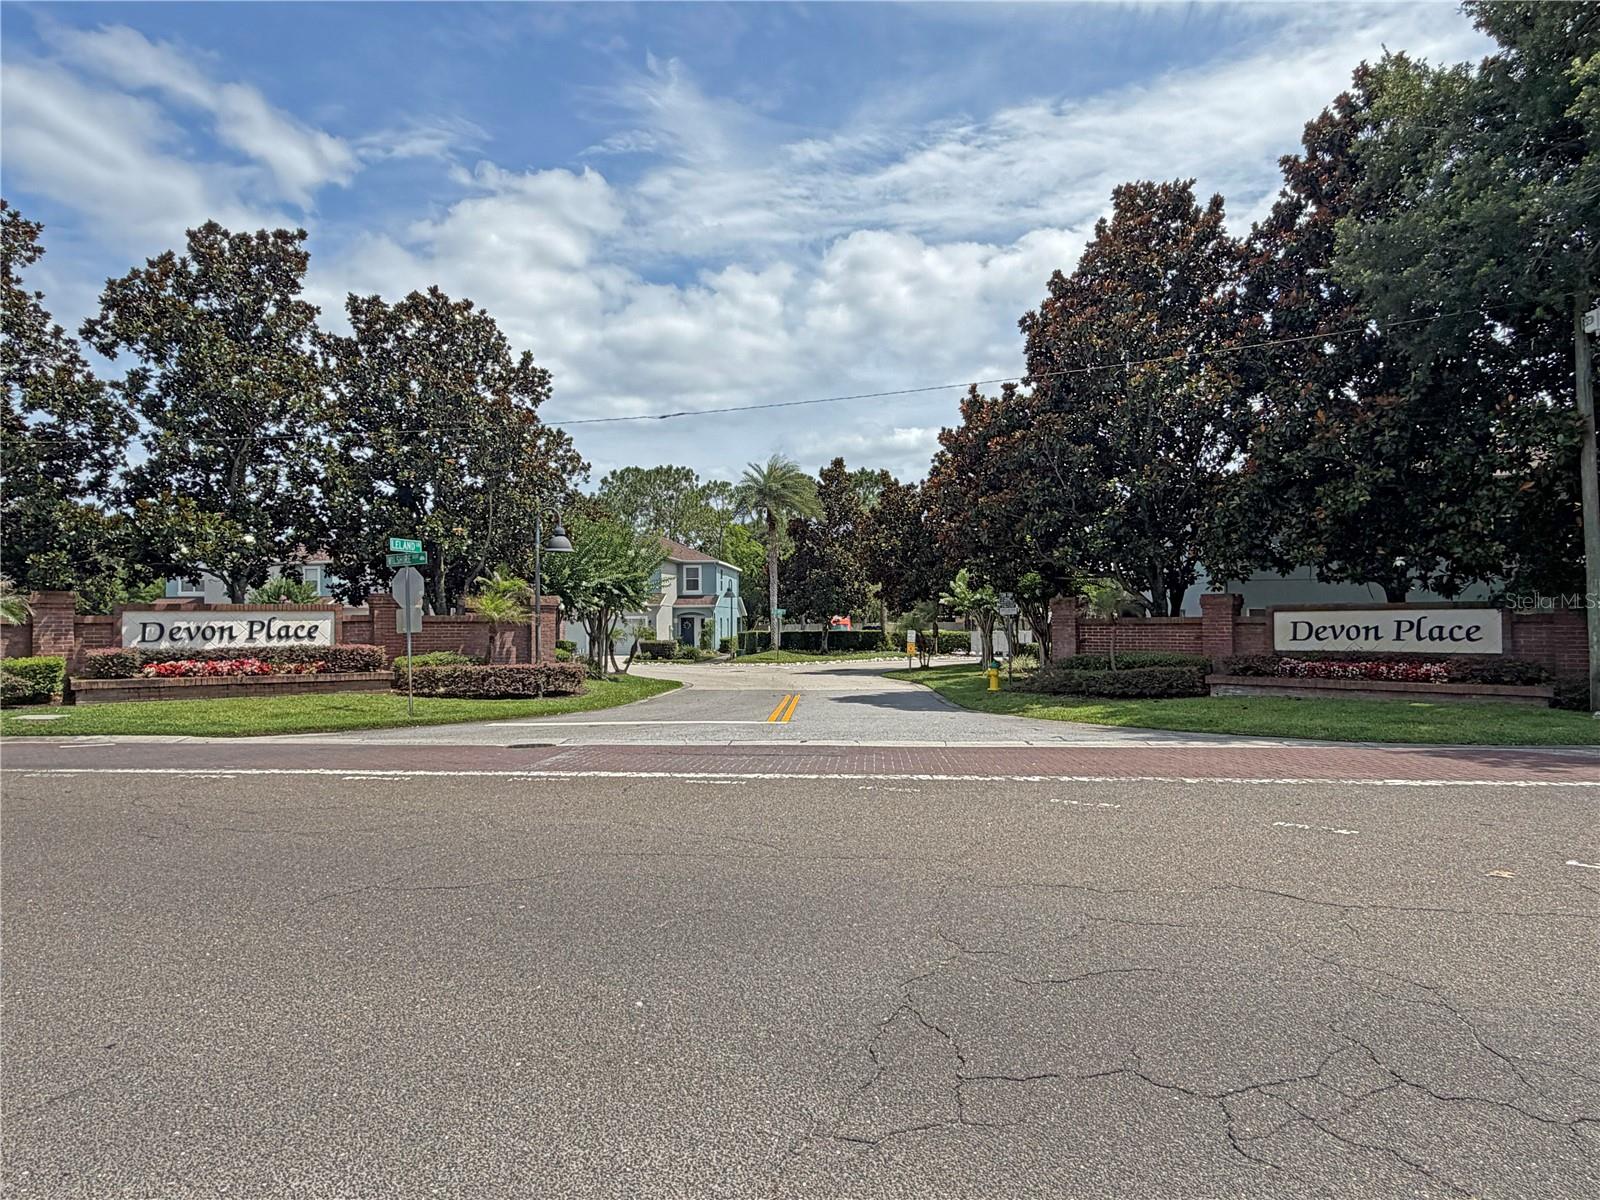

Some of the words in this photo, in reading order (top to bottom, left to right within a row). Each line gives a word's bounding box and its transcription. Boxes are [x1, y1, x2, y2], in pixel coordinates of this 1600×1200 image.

[392, 539, 416, 551] LELAND
[138, 621, 237, 643] Devon
[245, 617, 319, 642] Place
[1289, 620, 1384, 641] Devon
[1391, 616, 1483, 642] Place
